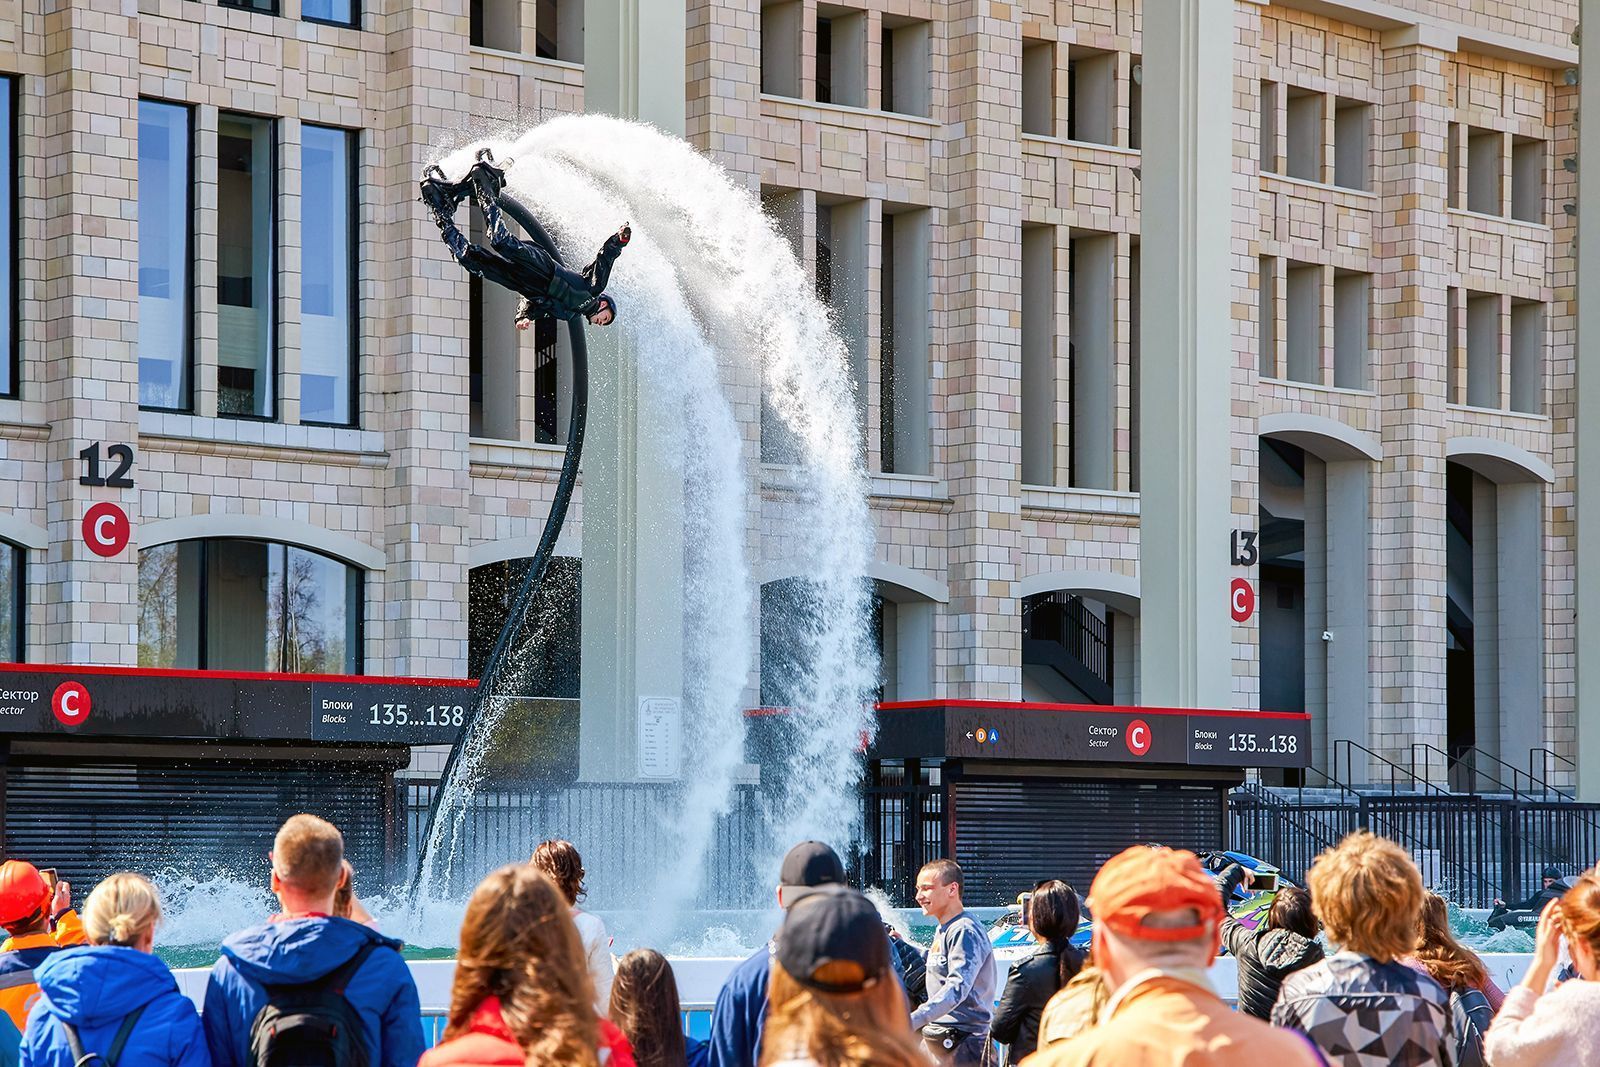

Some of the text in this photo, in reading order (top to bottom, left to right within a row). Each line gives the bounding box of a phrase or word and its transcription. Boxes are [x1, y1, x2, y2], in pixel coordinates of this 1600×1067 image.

[79, 441, 134, 489] 12
[94, 514, 116, 546] C
[1230, 528, 1258, 566] 13
[1232, 587, 1246, 613] C
[0, 705, 25, 715] ector
[61, 690, 79, 716] C
[321, 699, 353, 710] Блоки
[321, 714, 347, 723] Blocks
[369, 703, 464, 727] 135...138
[1088, 725, 1118, 738] Сектор
[1131, 727, 1145, 749] C
[1194, 729, 1218, 739] Блоки
[1088, 739, 1109, 747] Sector
[1194, 742, 1213, 750] Blocks
[1228, 733, 1297, 754] 135...138
